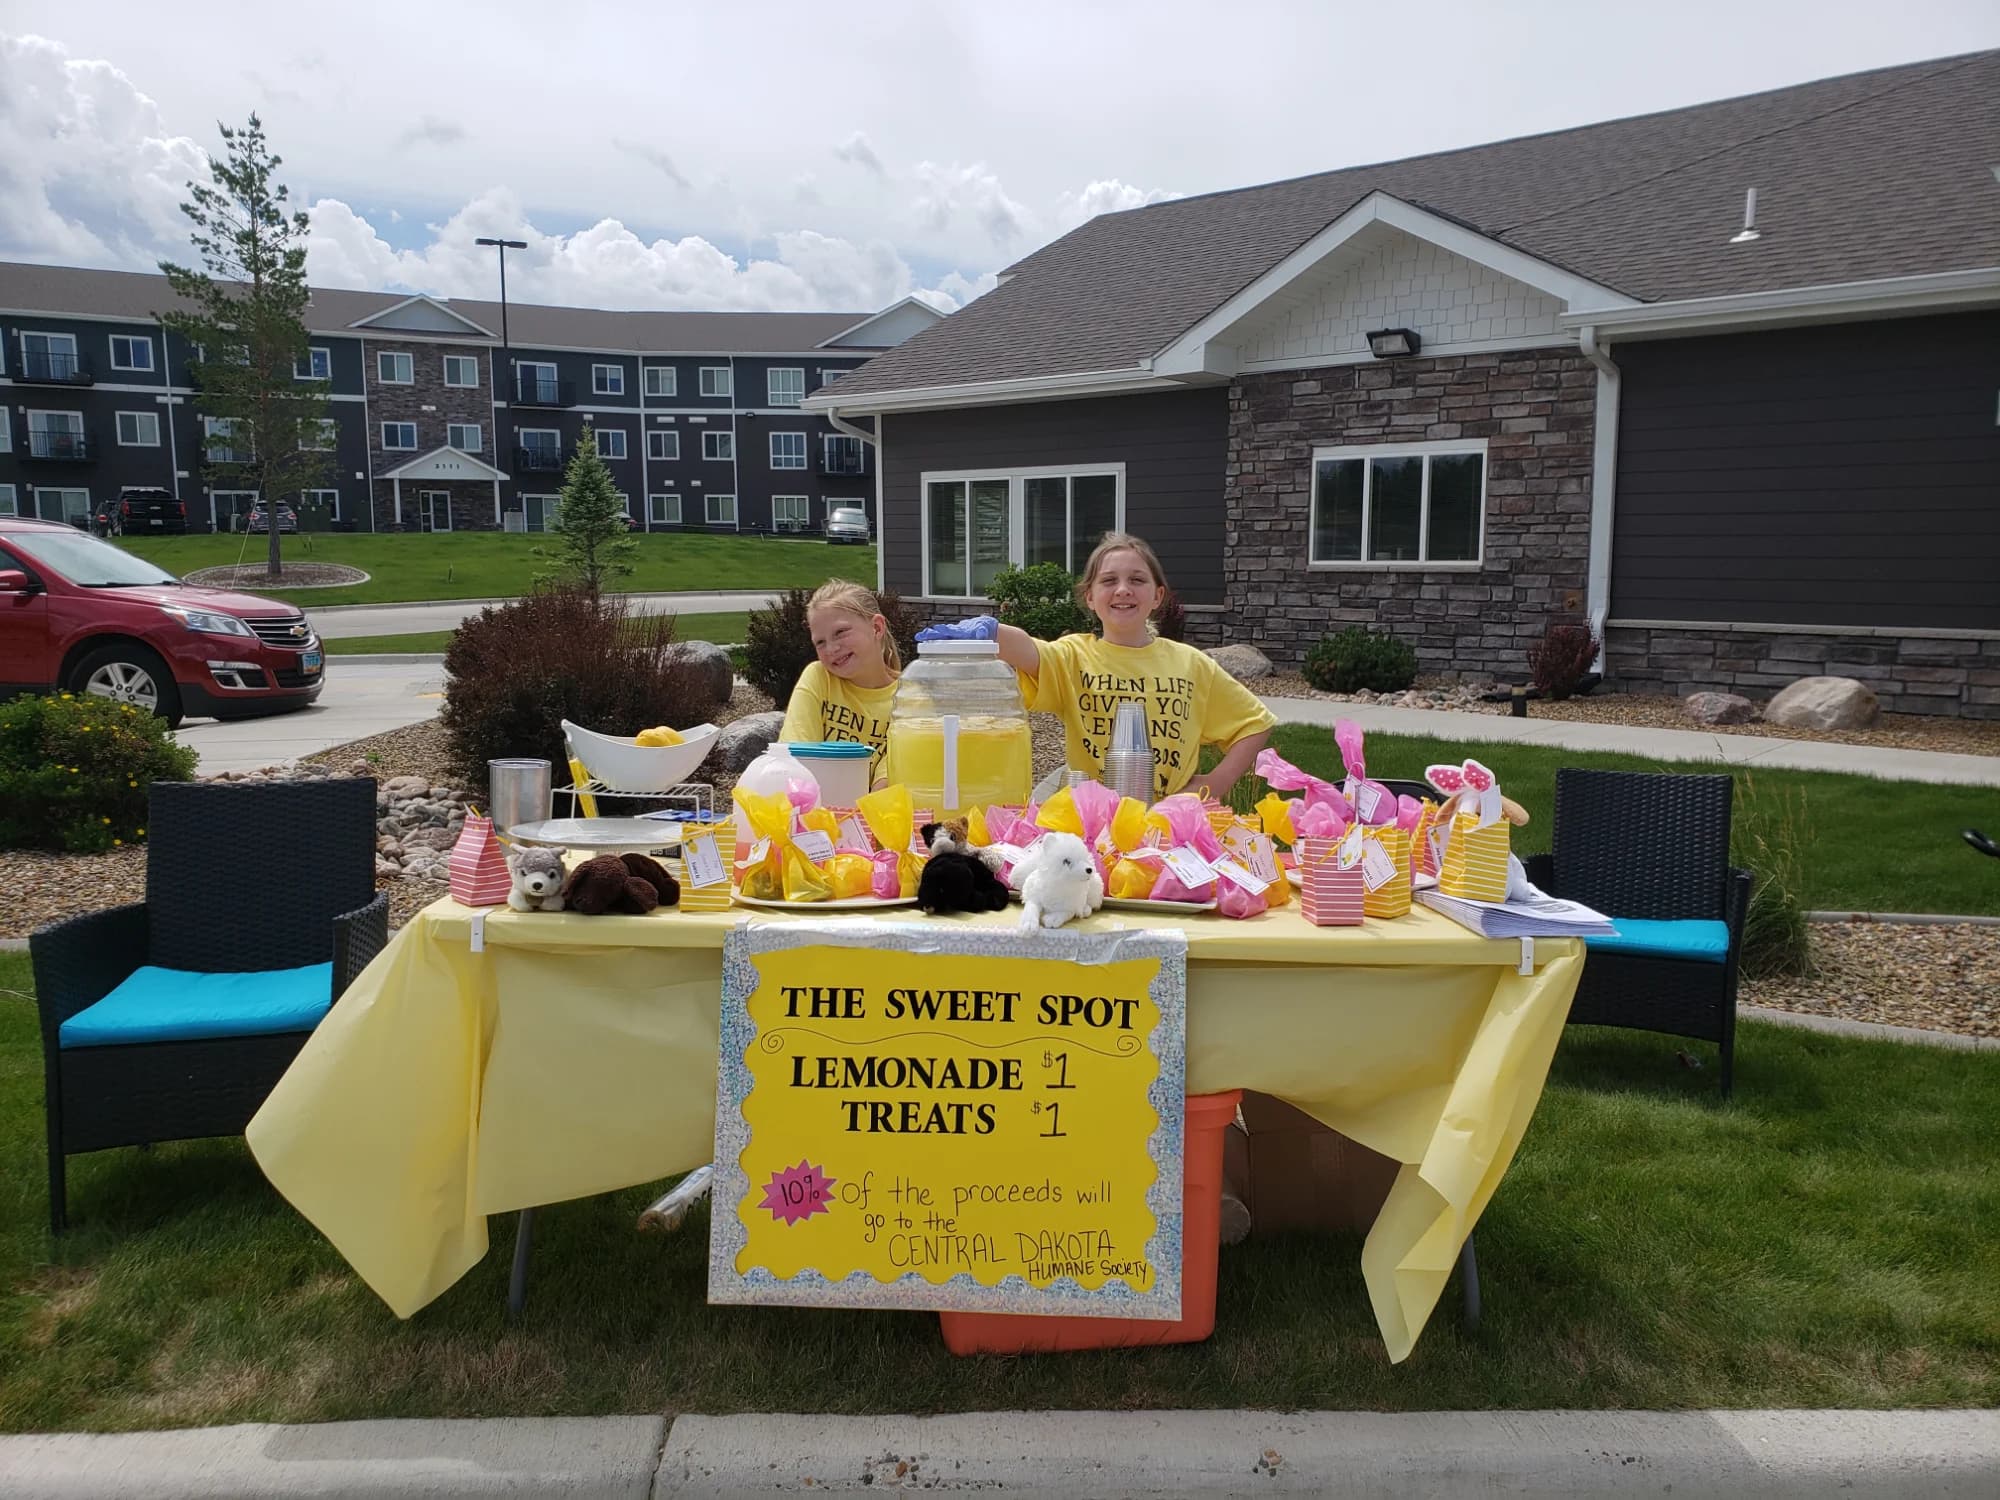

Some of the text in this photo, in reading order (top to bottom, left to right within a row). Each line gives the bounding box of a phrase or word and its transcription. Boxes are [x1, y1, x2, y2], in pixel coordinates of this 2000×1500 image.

[1080, 670, 1194, 700] WHEN LIFE
[1156, 697, 1190, 720] YOU
[781, 986, 1139, 1030] THE SWEET SPOT
[789, 1050, 1076, 1091] LEMONADE $1
[841, 1100, 1067, 1137] TREATS $1
[781, 1174, 820, 1207] 10%
[888, 1176, 934, 1206] the
[953, 1178, 1063, 1216] proceeds
[1076, 1179, 1111, 1204] will
[864, 1210, 957, 1243] go to the
[889, 1229, 1116, 1270] CENTRAL DAKOTA
[1028, 1260, 1095, 1281] HUMANE
